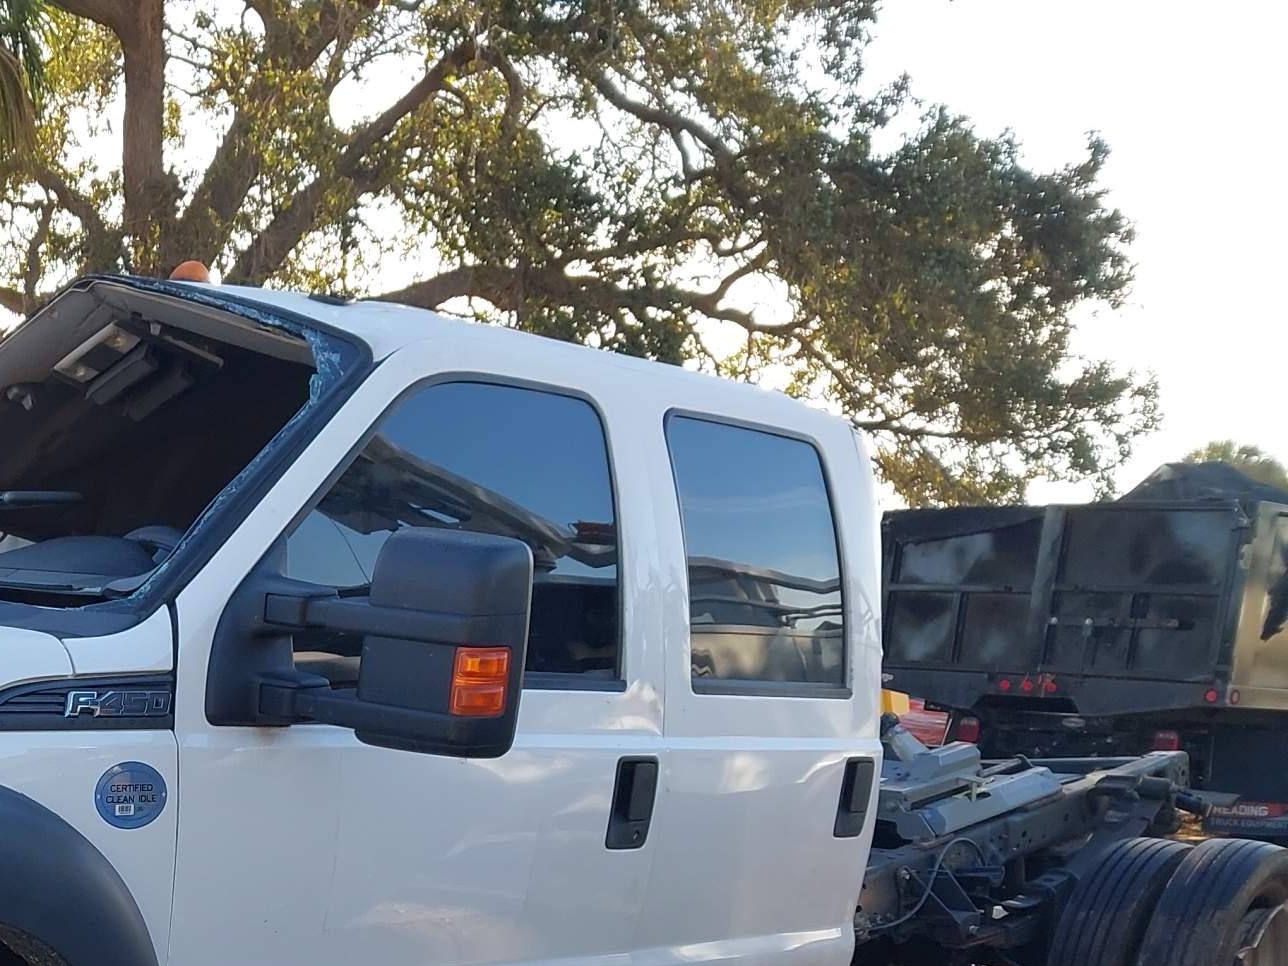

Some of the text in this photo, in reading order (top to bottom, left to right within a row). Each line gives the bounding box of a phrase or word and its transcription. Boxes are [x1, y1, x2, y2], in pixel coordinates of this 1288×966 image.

[65, 691, 172, 718] F-450
[110, 784, 154, 793] CERTIFIED
[105, 794, 158, 804] CLEAN IDLE
